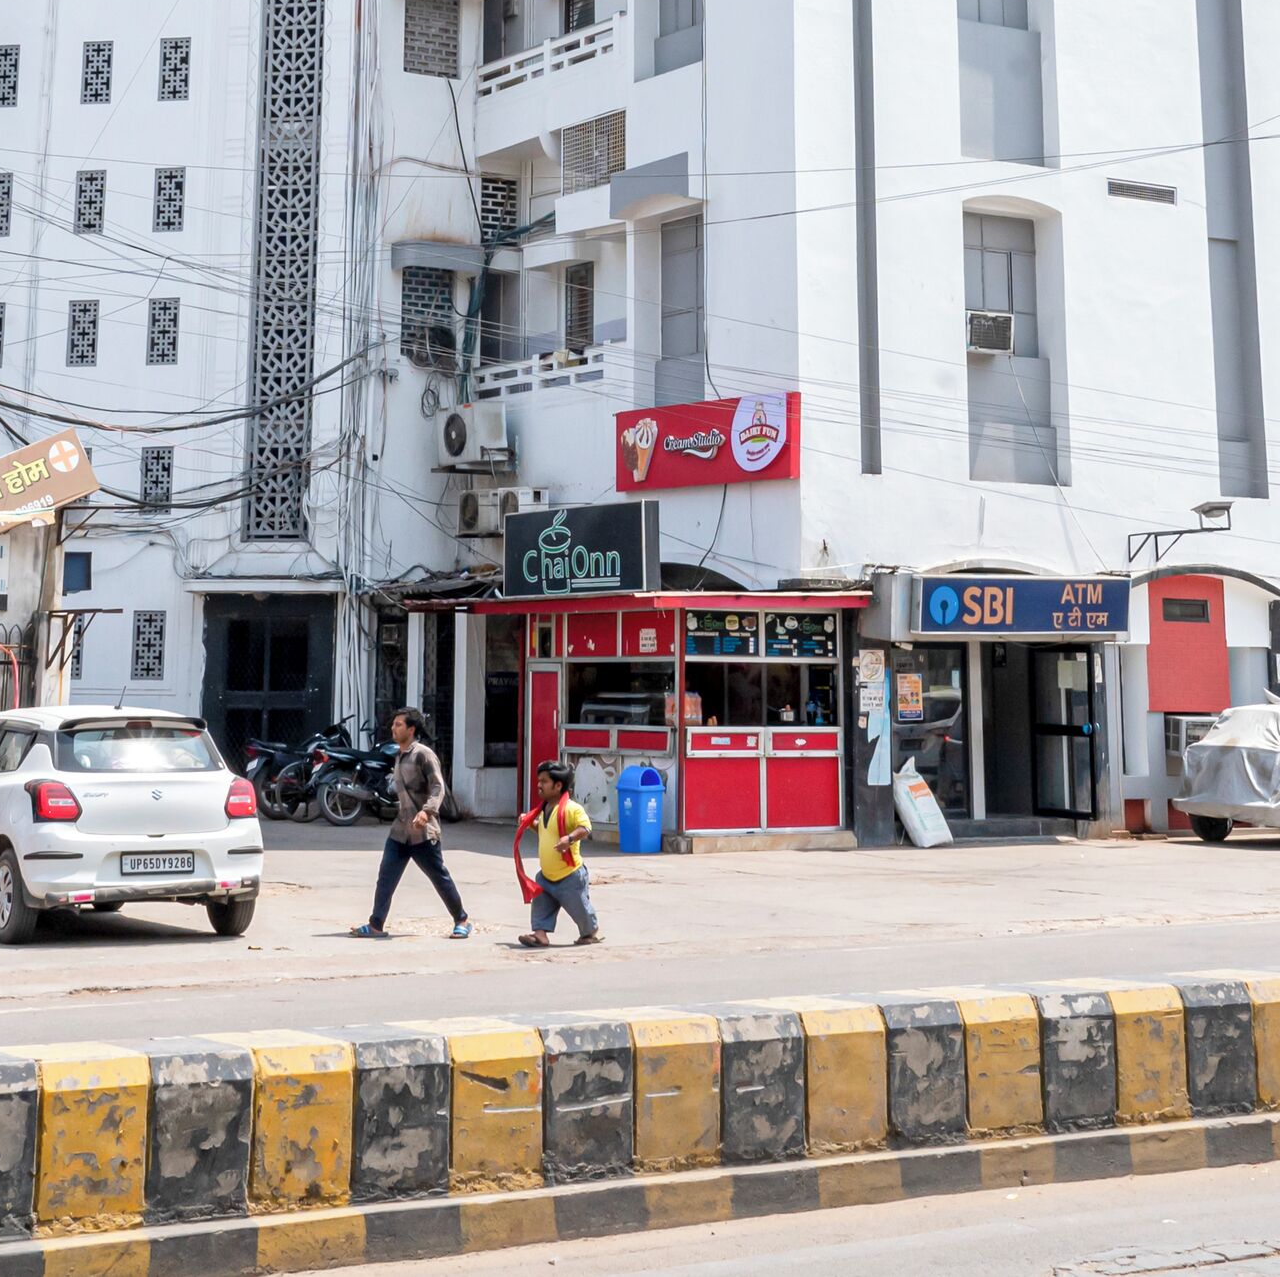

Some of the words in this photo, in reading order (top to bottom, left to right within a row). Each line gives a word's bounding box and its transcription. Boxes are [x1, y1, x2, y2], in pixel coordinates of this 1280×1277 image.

[663, 435, 691, 451] Cream
[692, 429, 722, 448] Studio
[2, 457, 51, 495] होम
[962, 585, 1014, 626] SBI
[1060, 583, 1102, 604] ATM
[1086, 611, 1109, 629] एम
[130, 856, 192, 870] UP65DY9286
